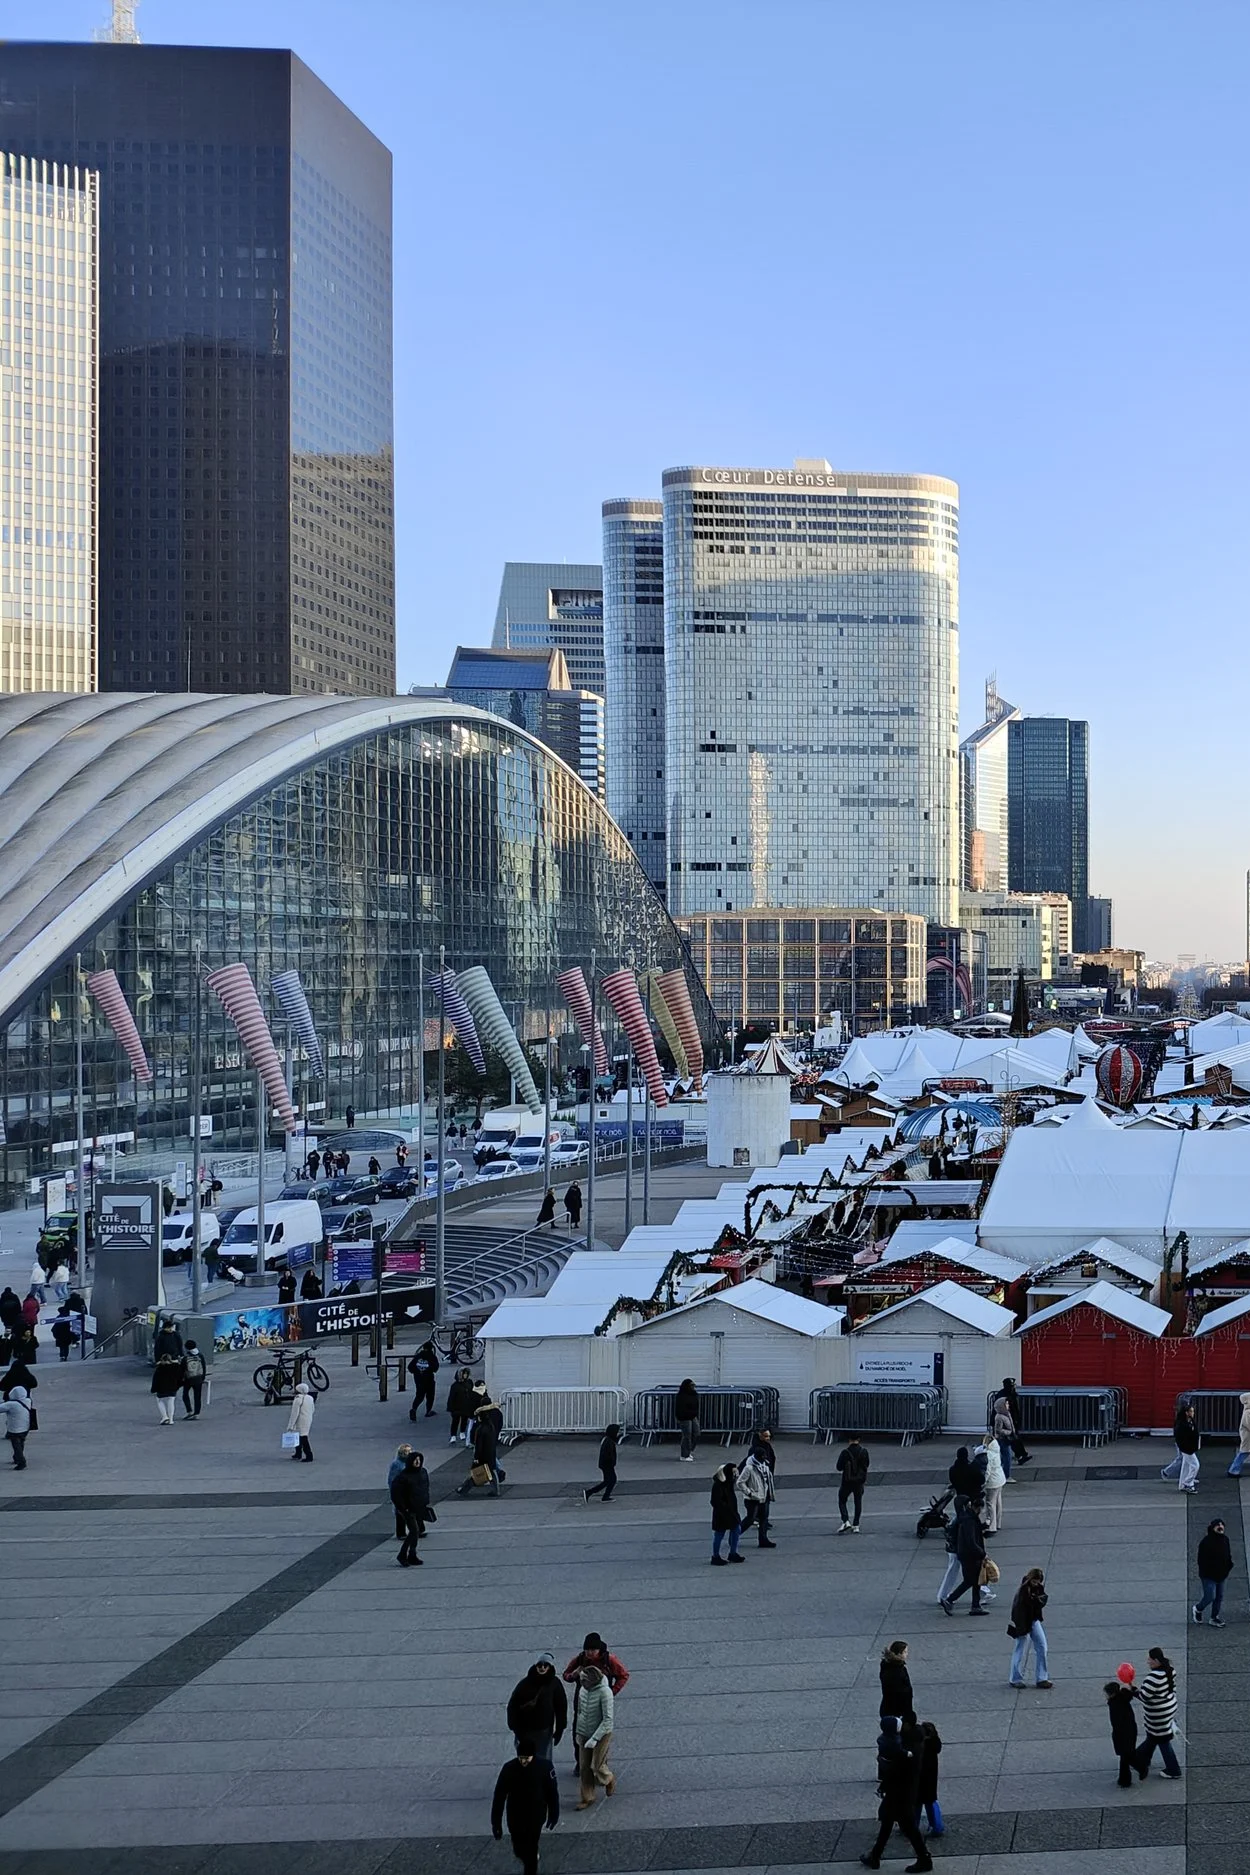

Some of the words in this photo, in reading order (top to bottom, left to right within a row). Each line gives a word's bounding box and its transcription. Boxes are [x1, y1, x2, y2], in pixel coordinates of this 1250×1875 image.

[702, 467, 751, 483] Cœur
[764, 469, 835, 486] Défense
[100, 1213, 120, 1222] CITÉ
[98, 1225, 156, 1233] L'HISTOIRE
[318, 1303, 345, 1317] CITÉ
[348, 1308, 359, 1316] DE
